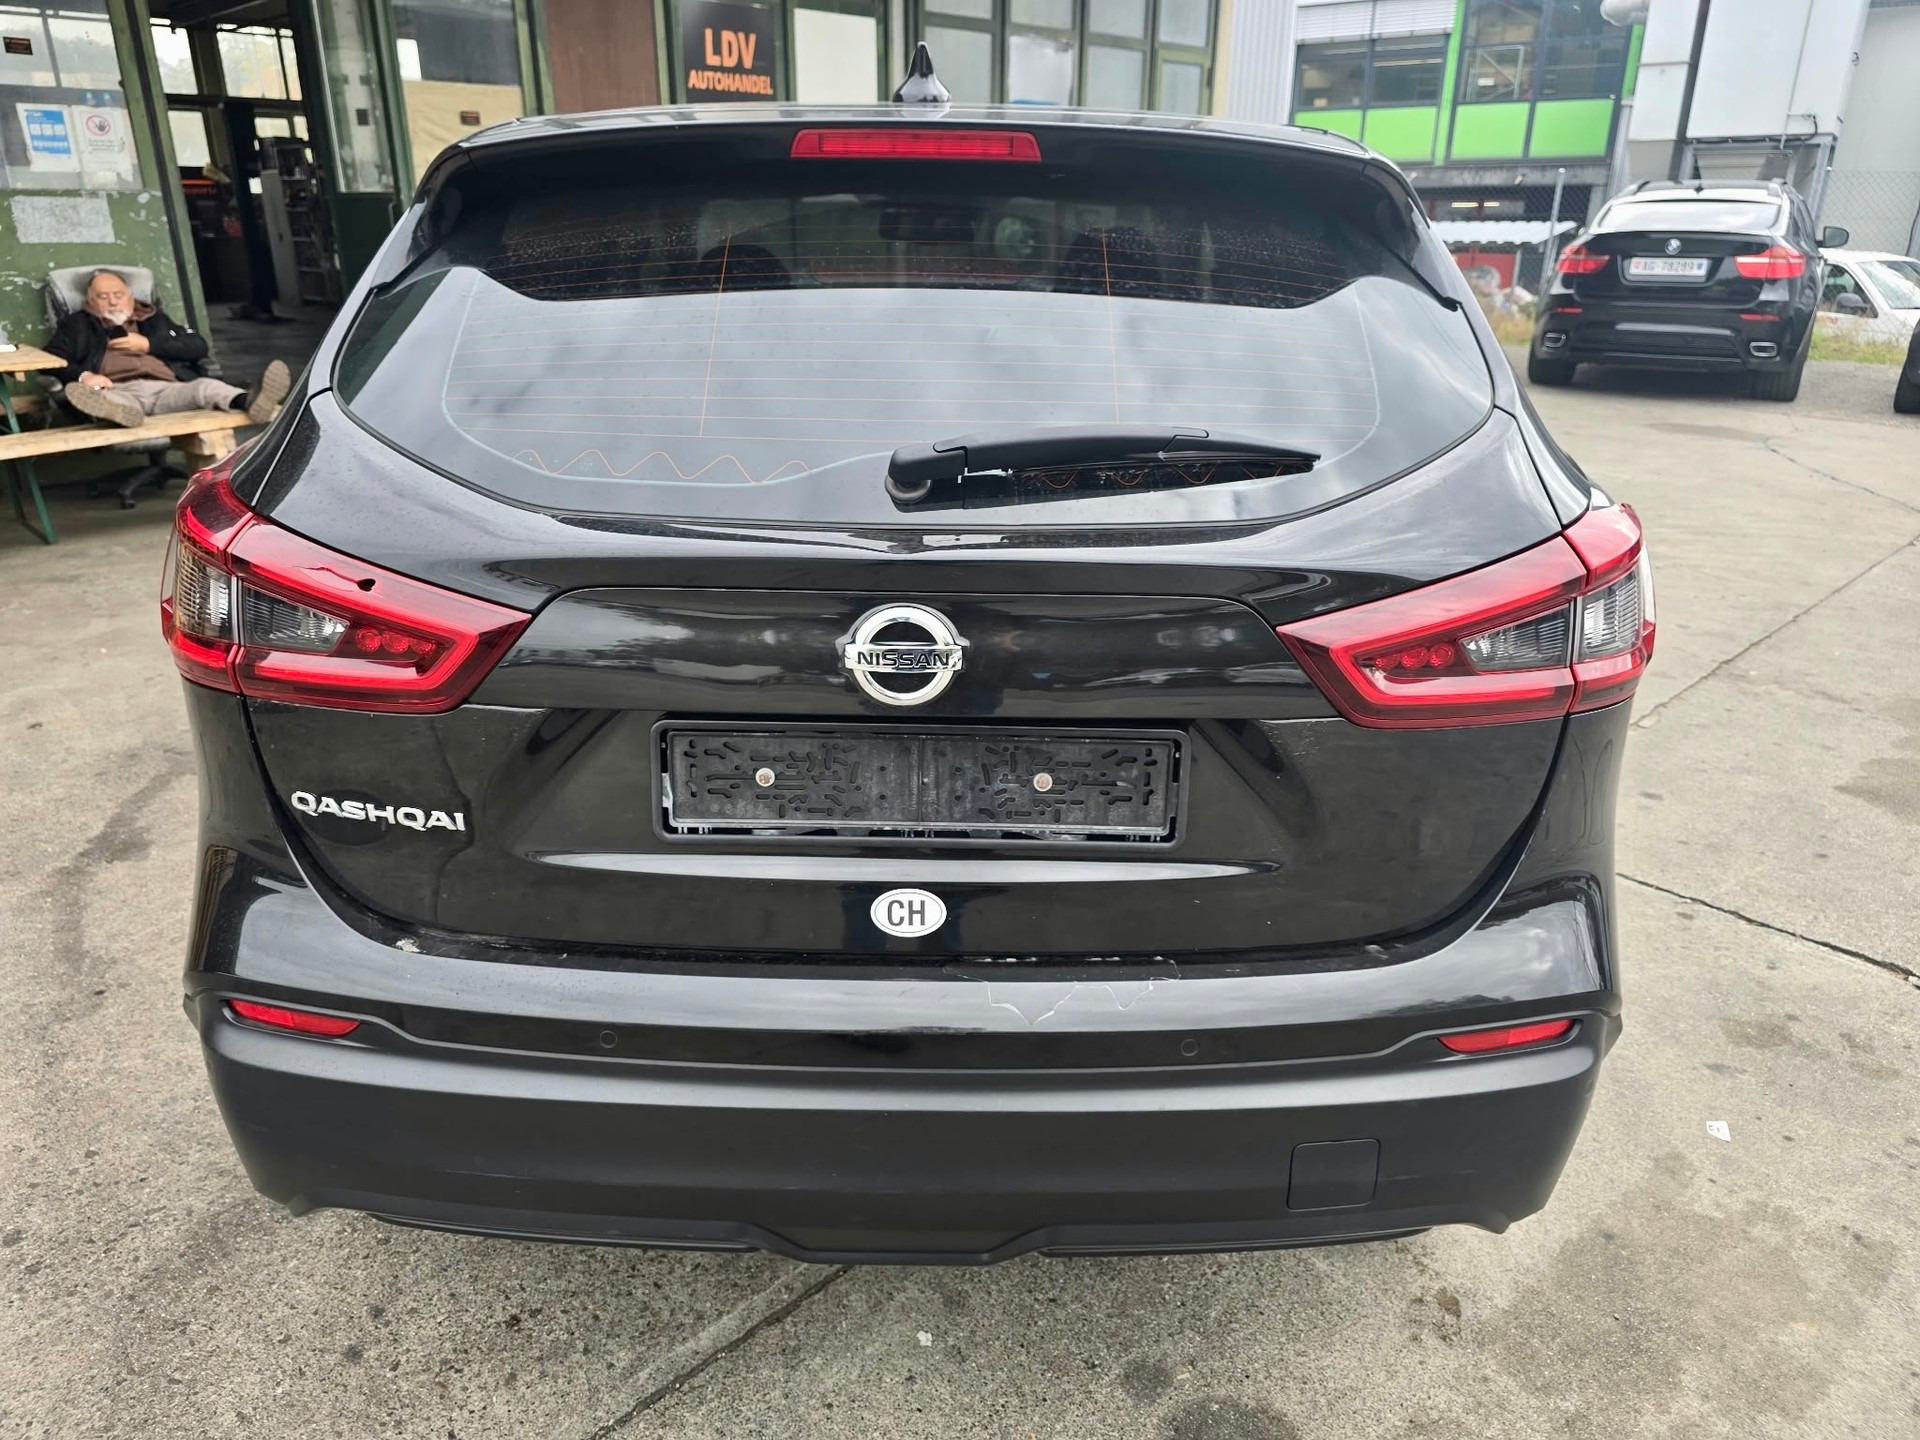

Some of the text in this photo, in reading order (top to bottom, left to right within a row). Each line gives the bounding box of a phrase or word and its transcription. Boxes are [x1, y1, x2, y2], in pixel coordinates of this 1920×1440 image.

[704, 27, 757, 70] LDV
[687, 69, 774, 95] AUTOHANDEL
[857, 651, 950, 667] NISSAN
[290, 790, 466, 832] QASHQAI
[887, 899, 926, 927] CH
